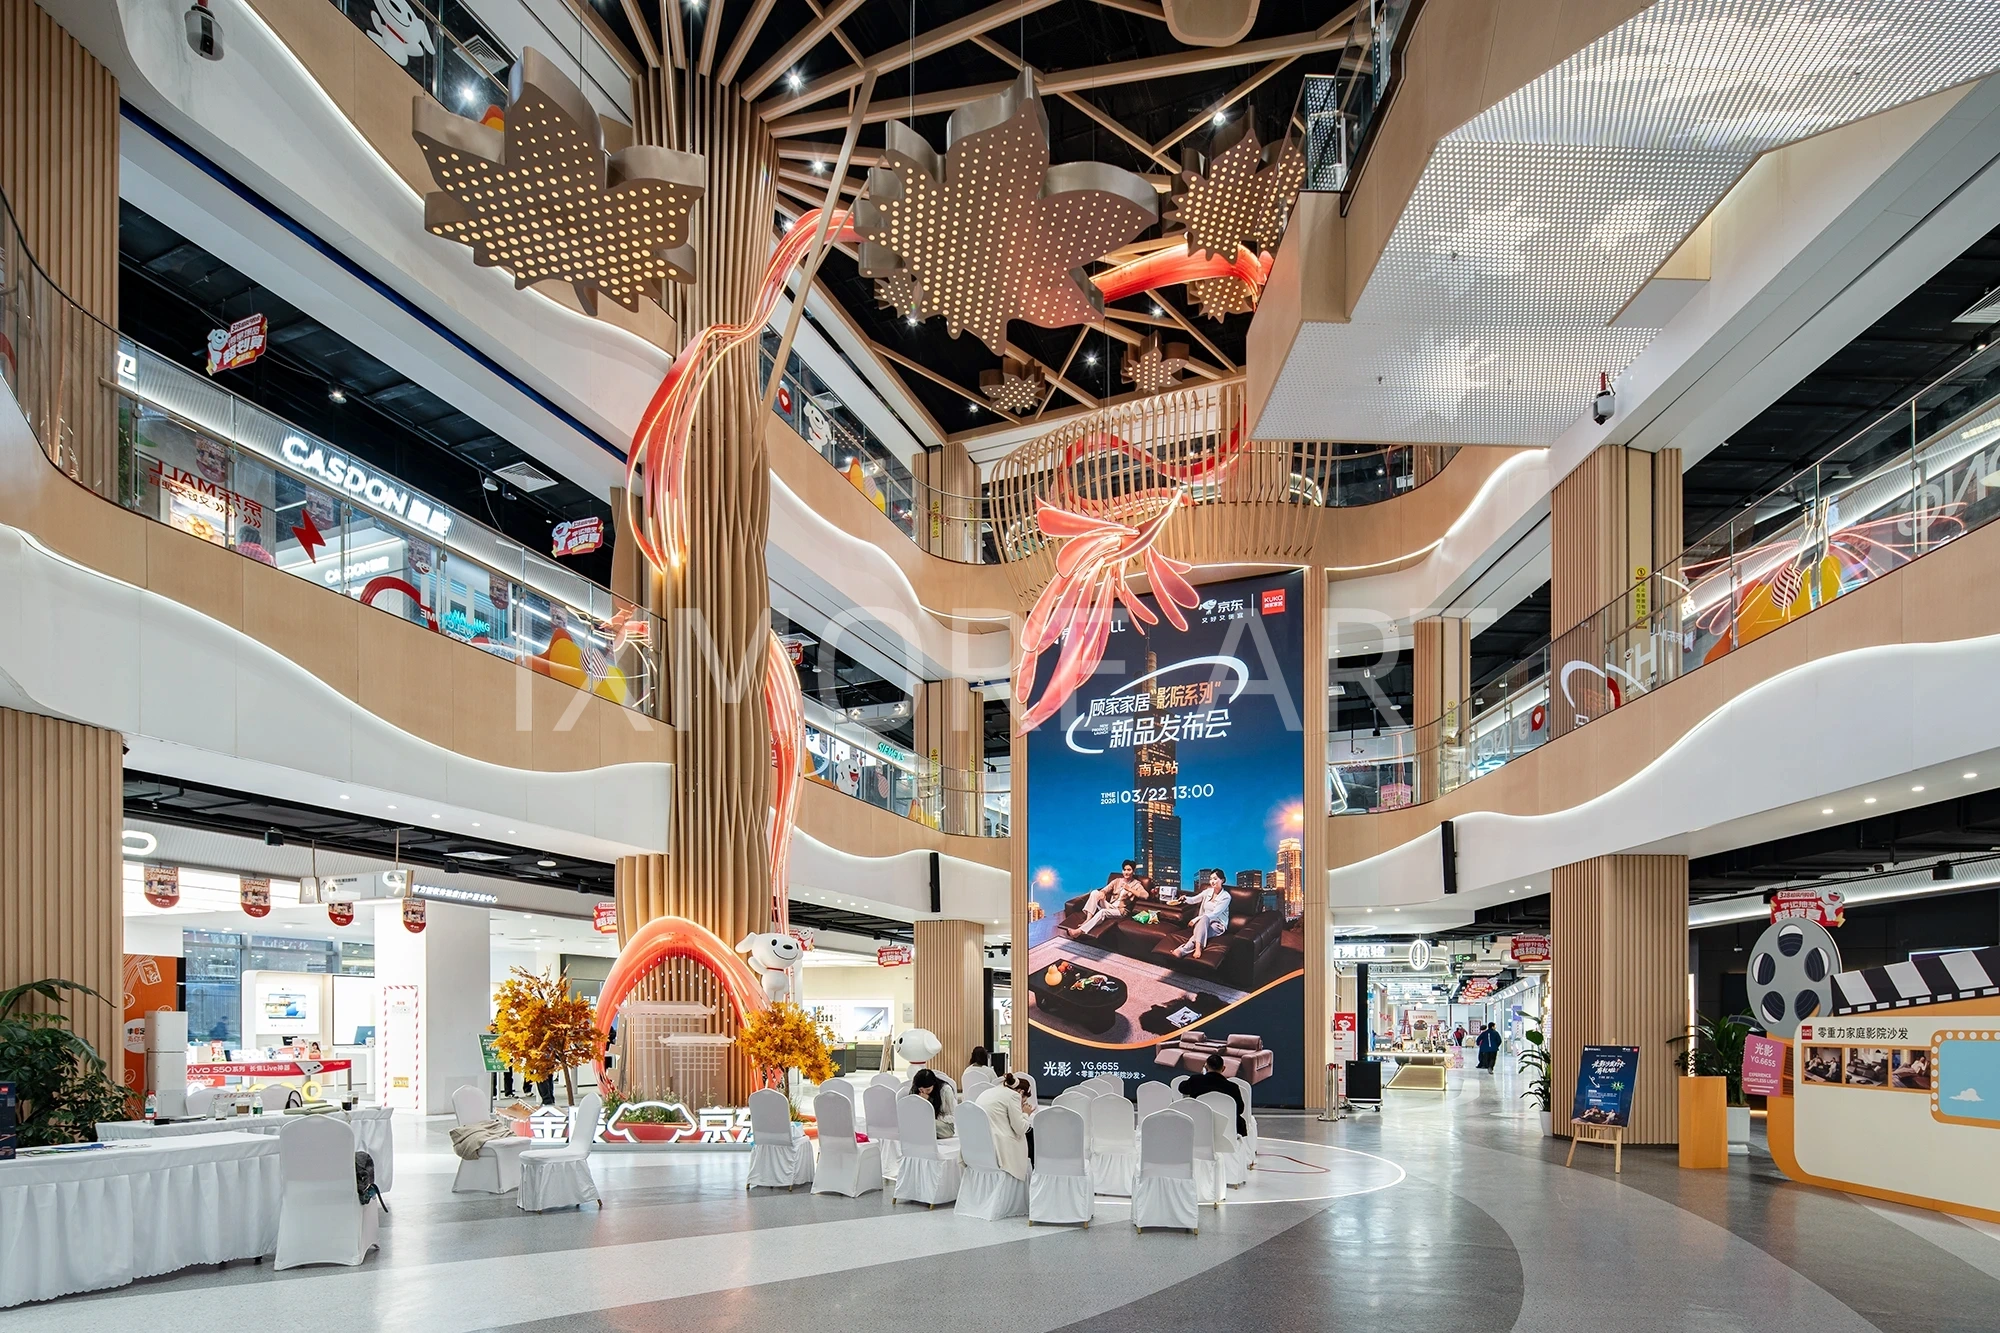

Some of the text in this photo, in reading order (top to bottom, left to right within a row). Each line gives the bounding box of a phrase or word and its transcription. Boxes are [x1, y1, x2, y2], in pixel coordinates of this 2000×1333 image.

[282, 435, 409, 516] CASDON
[1217, 599, 1243, 613] 京东
[1201, 612, 1244, 624] 又好又便宜
[1109, 708, 1232, 748] 新品发布会
[878, 741, 905, 762] SIEMENS
[1138, 760, 1179, 777] 南京站
[1120, 783, 1214, 804] 03/22 13:00
[1817, 1027, 1909, 1040] 零重力家庭影院沙发
[1754, 1043, 1774, 1057] 光影
[1080, 1061, 1119, 1071] YG.6655
[1750, 1055, 1777, 1068] YG.6655
[212, 1066, 246, 1074] S50系列
[1043, 1061, 1072, 1077] 光影
